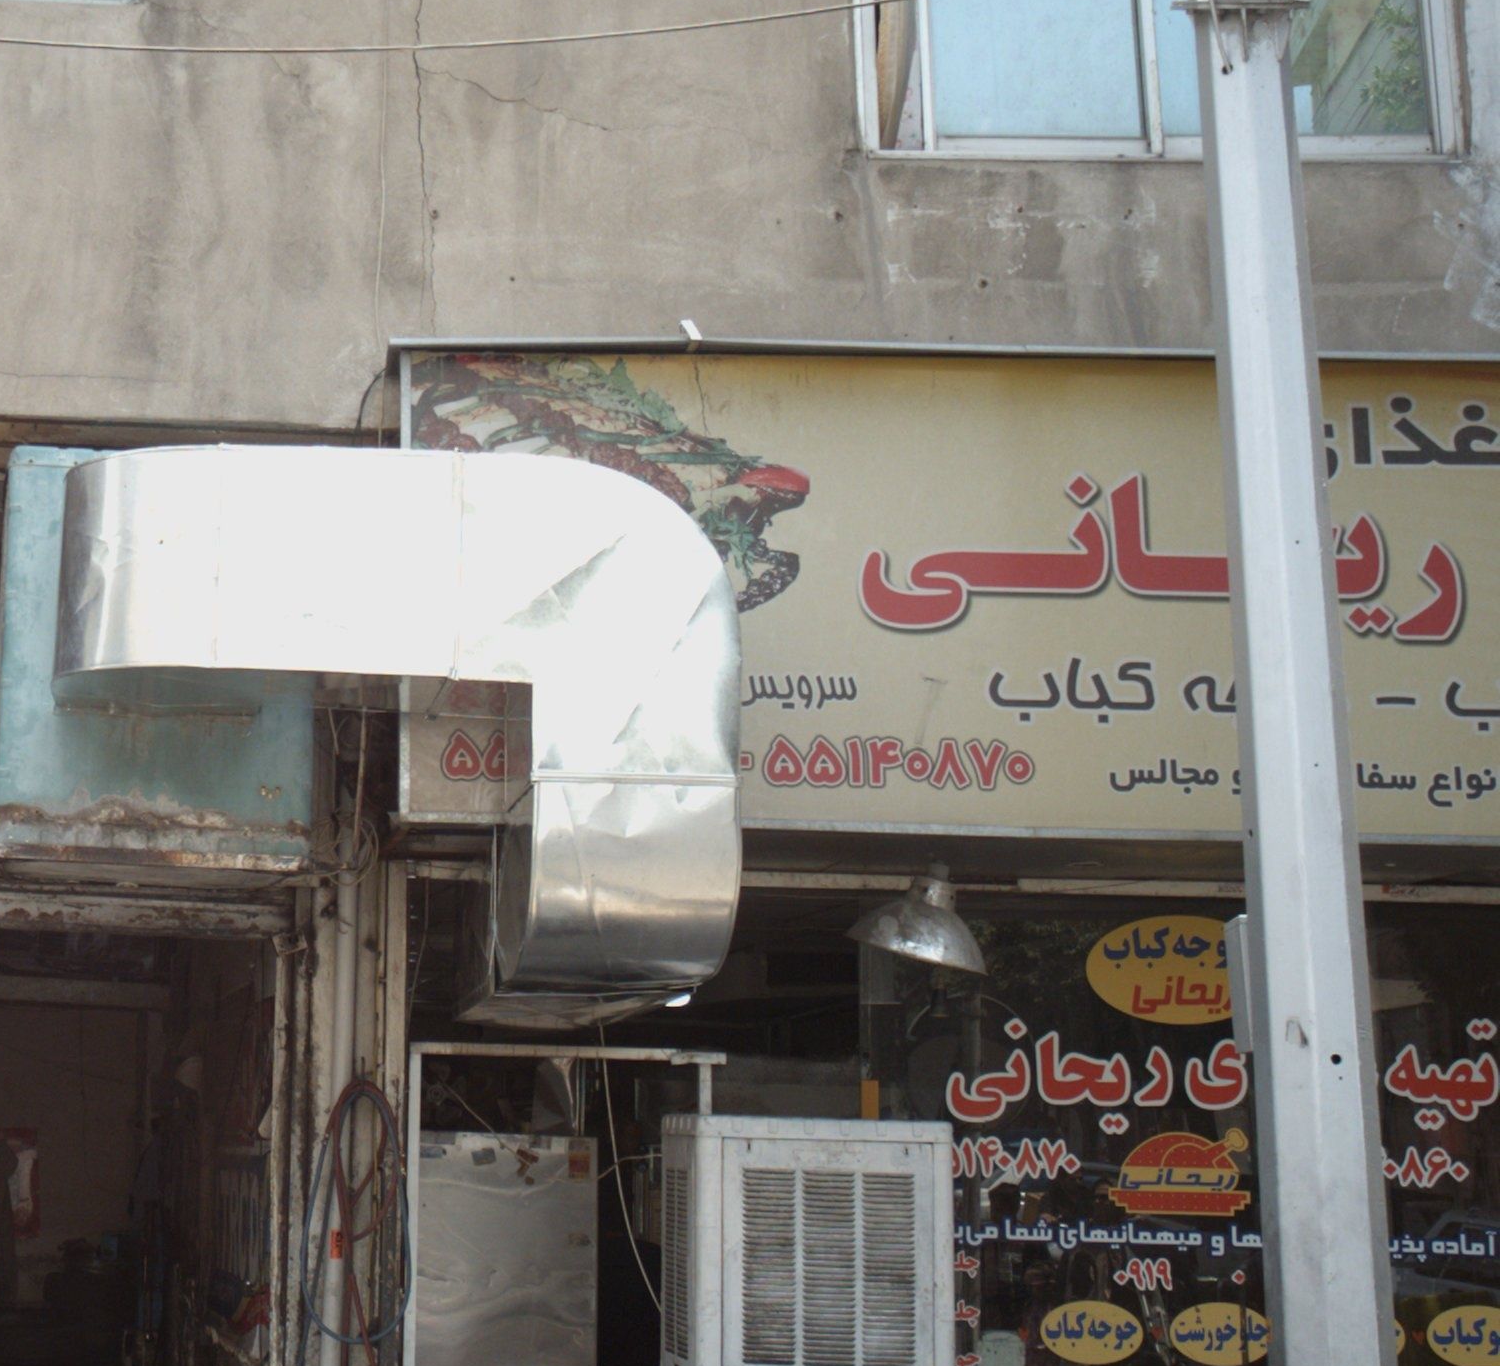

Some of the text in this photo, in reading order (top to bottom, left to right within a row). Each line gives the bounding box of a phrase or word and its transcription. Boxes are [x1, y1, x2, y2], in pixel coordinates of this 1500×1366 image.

[861, 474, 1465, 642] ریانی
[989, 658, 1156, 724] کباب
[763, 735, 1035, 791] ۵۵۱۴۰۸۷۰
[1109, 759, 1219, 793] مجالس
[1103, 926, 1228, 969] وجه کباب
[946, 1017, 1174, 1135] ریحانی
[1384, 1018, 1499, 1130] تهیه
[1119, 1168, 1238, 1192] ریحانی
[1004, 1218, 1053, 1242] شما
[1210, 1238, 1225, 1256] و
[1431, 1230, 1495, 1257] آماده
[1045, 1310, 1138, 1349] جوجه کباب
[1174, 1313, 1237, 1351] خورشت
[1432, 1317, 1487, 1353] کباب
